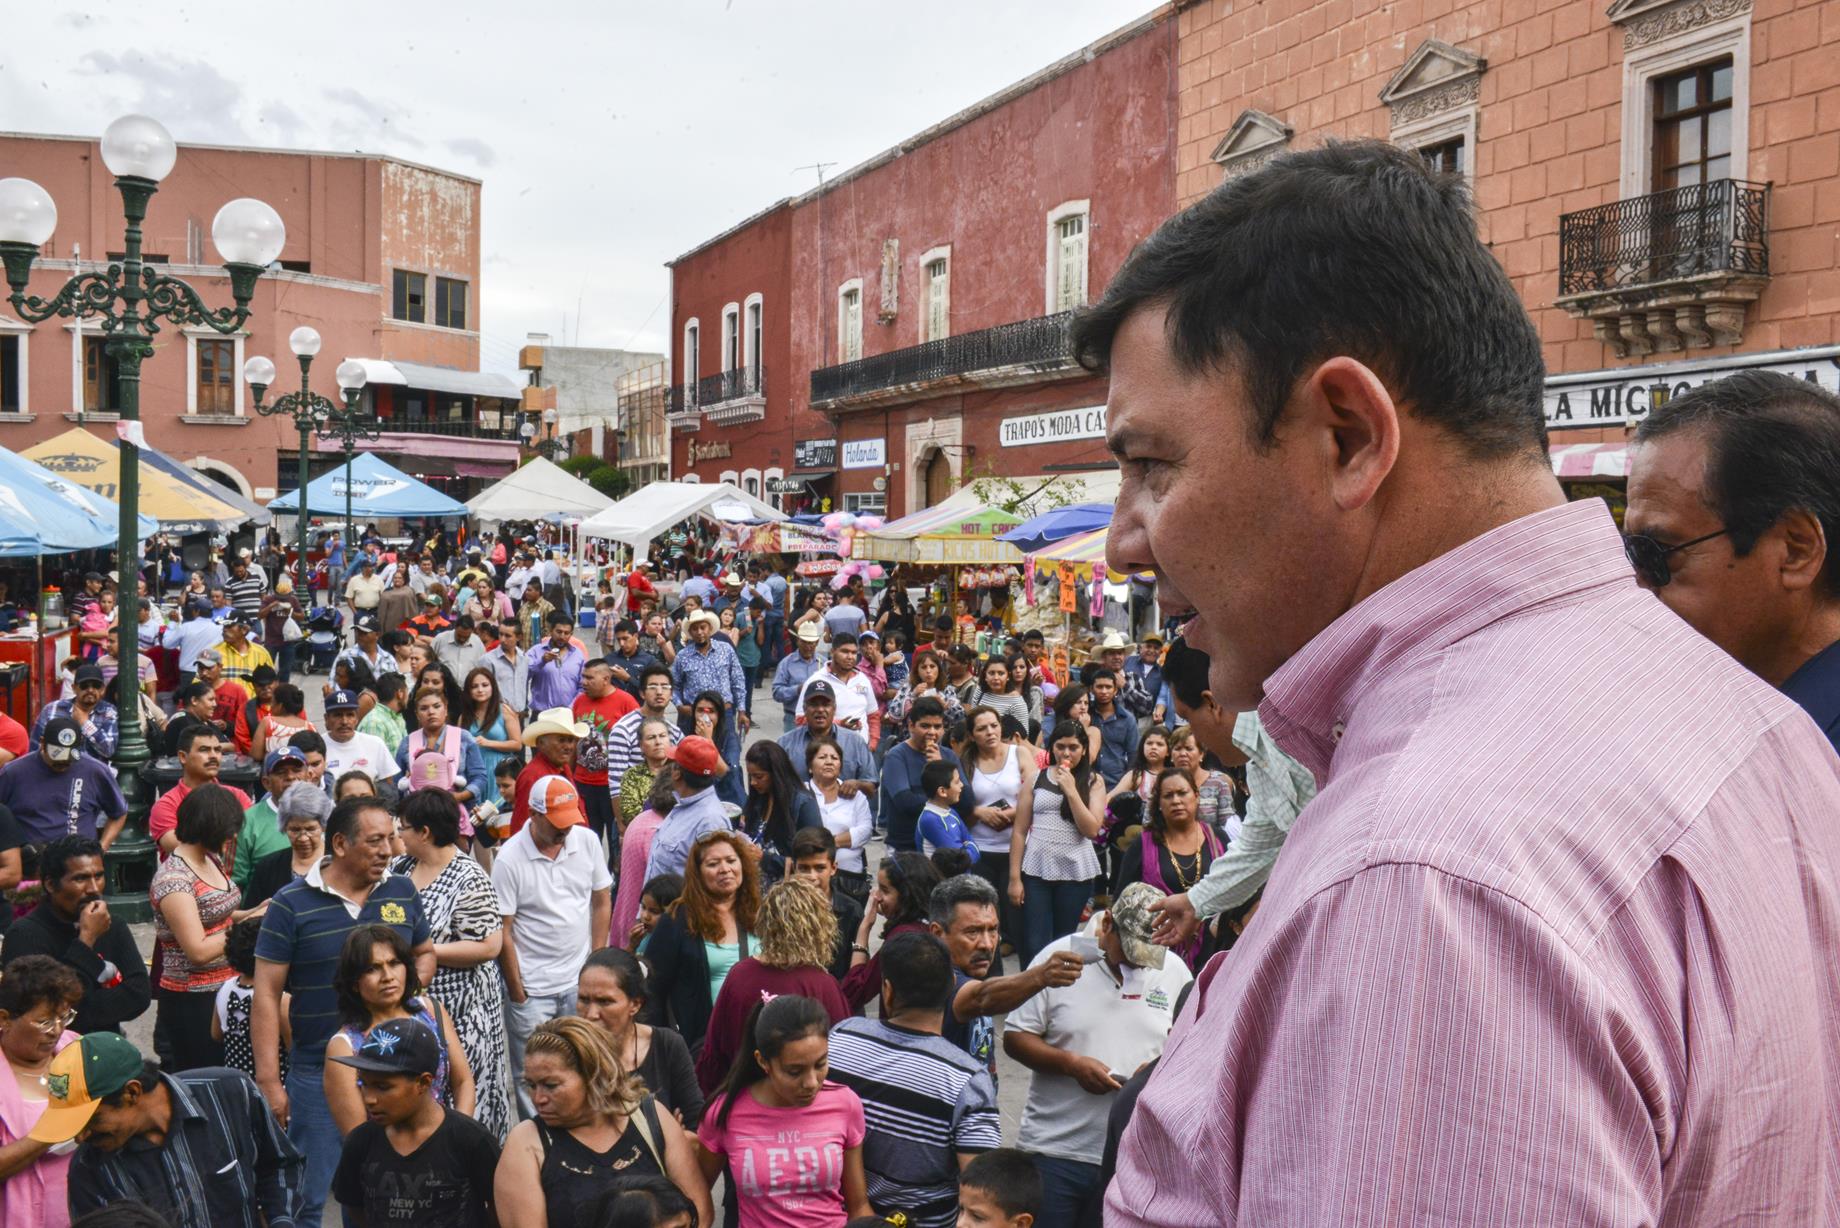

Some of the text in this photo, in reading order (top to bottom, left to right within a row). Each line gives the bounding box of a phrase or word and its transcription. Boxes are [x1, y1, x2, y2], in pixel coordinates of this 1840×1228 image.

[1005, 418, 1045, 441] TRAPO'S
[1049, 414, 1081, 437] MODA
[961, 523, 980, 535] HOT
[777, 1130, 801, 1144] NYC
[742, 1142, 844, 1197] AERO
[389, 1198, 415, 1209] NEW
[388, 1208, 415, 1219] CITY
